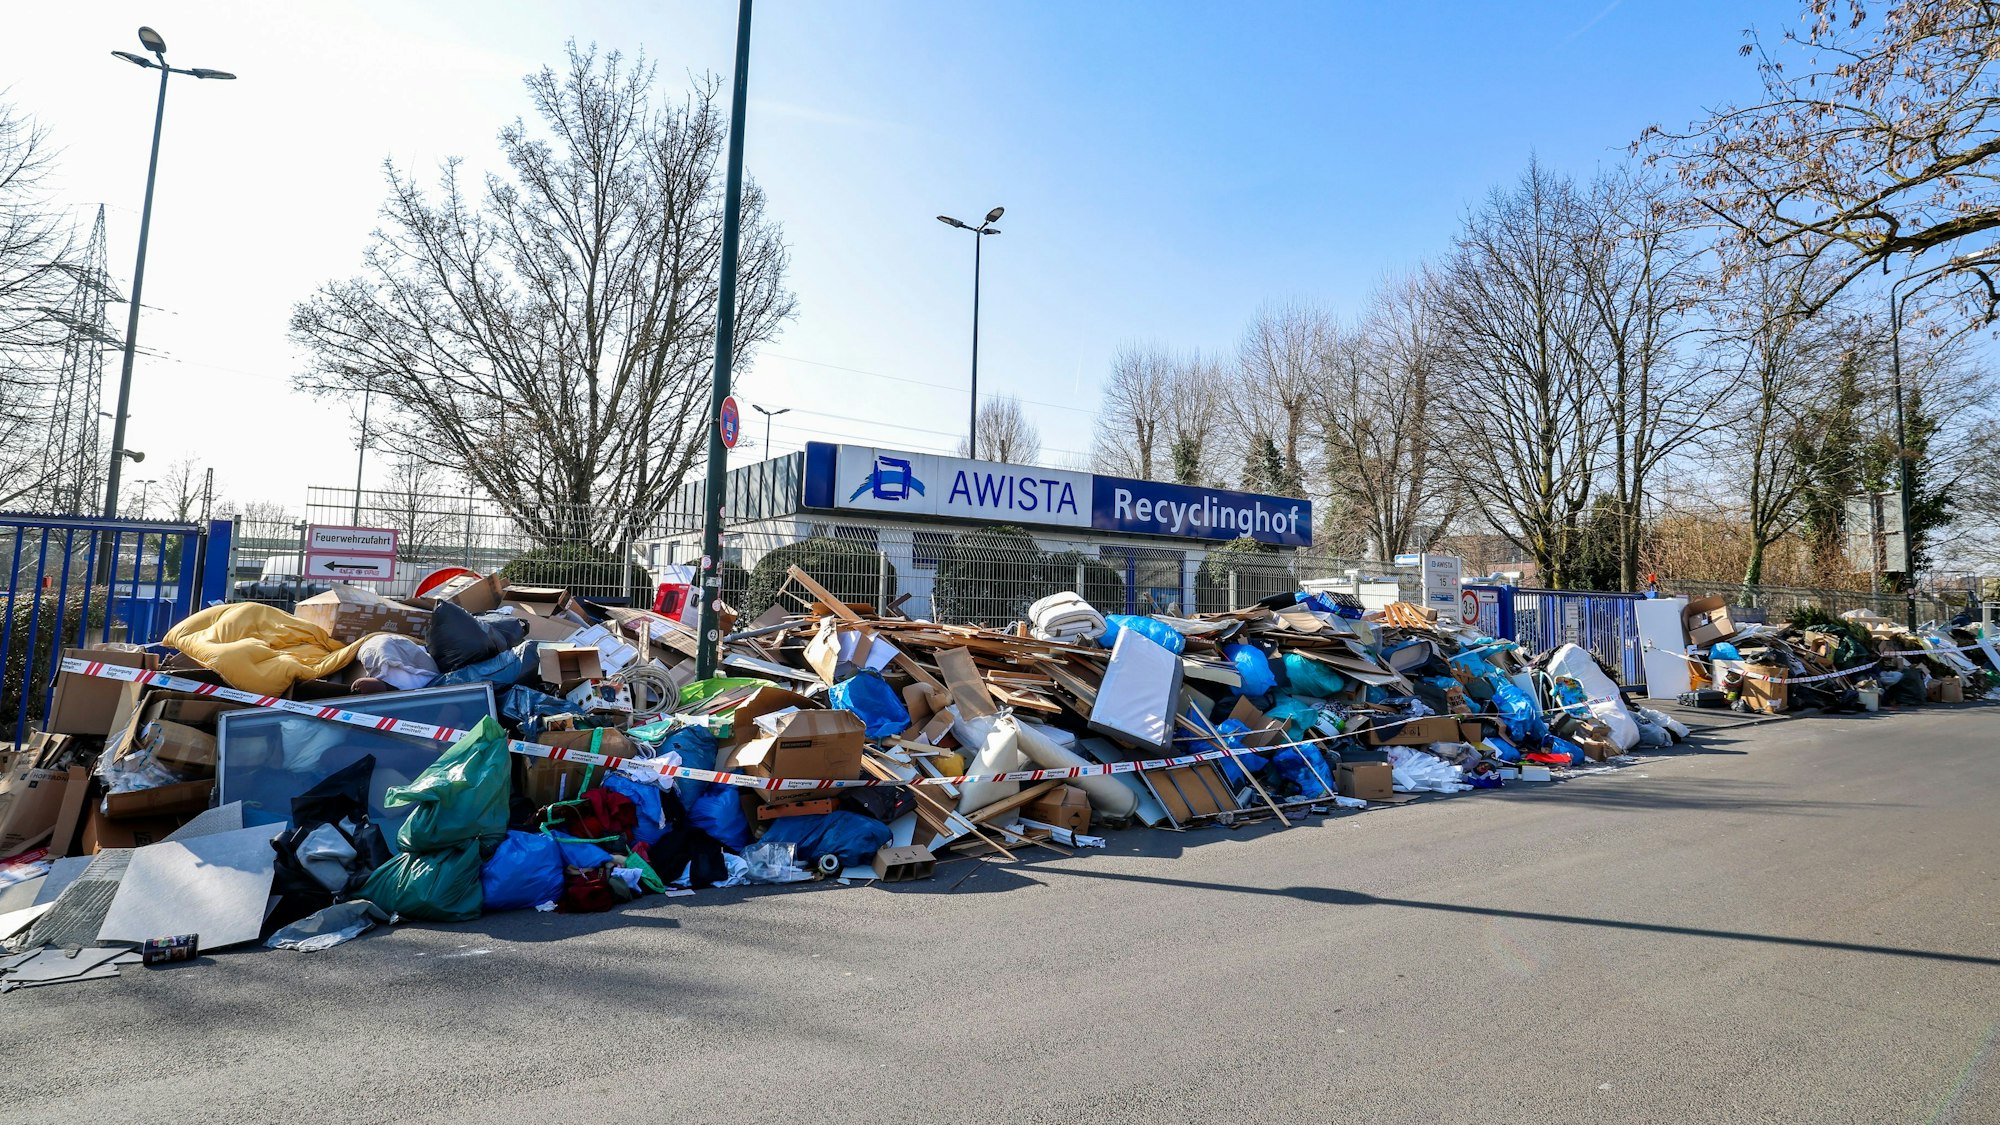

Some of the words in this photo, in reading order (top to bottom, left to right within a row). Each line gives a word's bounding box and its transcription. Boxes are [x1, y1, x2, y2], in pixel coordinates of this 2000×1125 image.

[949, 471, 1078, 515] AWISTA
[1114, 488, 1299, 538] Recyclinghof
[315, 532, 391, 545] Feuerwehrzufahrt
[1437, 561, 1453, 569] AWISTA
[1440, 577, 1447, 587] 15
[1463, 600, 1475, 615] 3,5t
[284, 701, 314, 711] Entsorgung
[401, 722, 430, 732] Umweltamt
